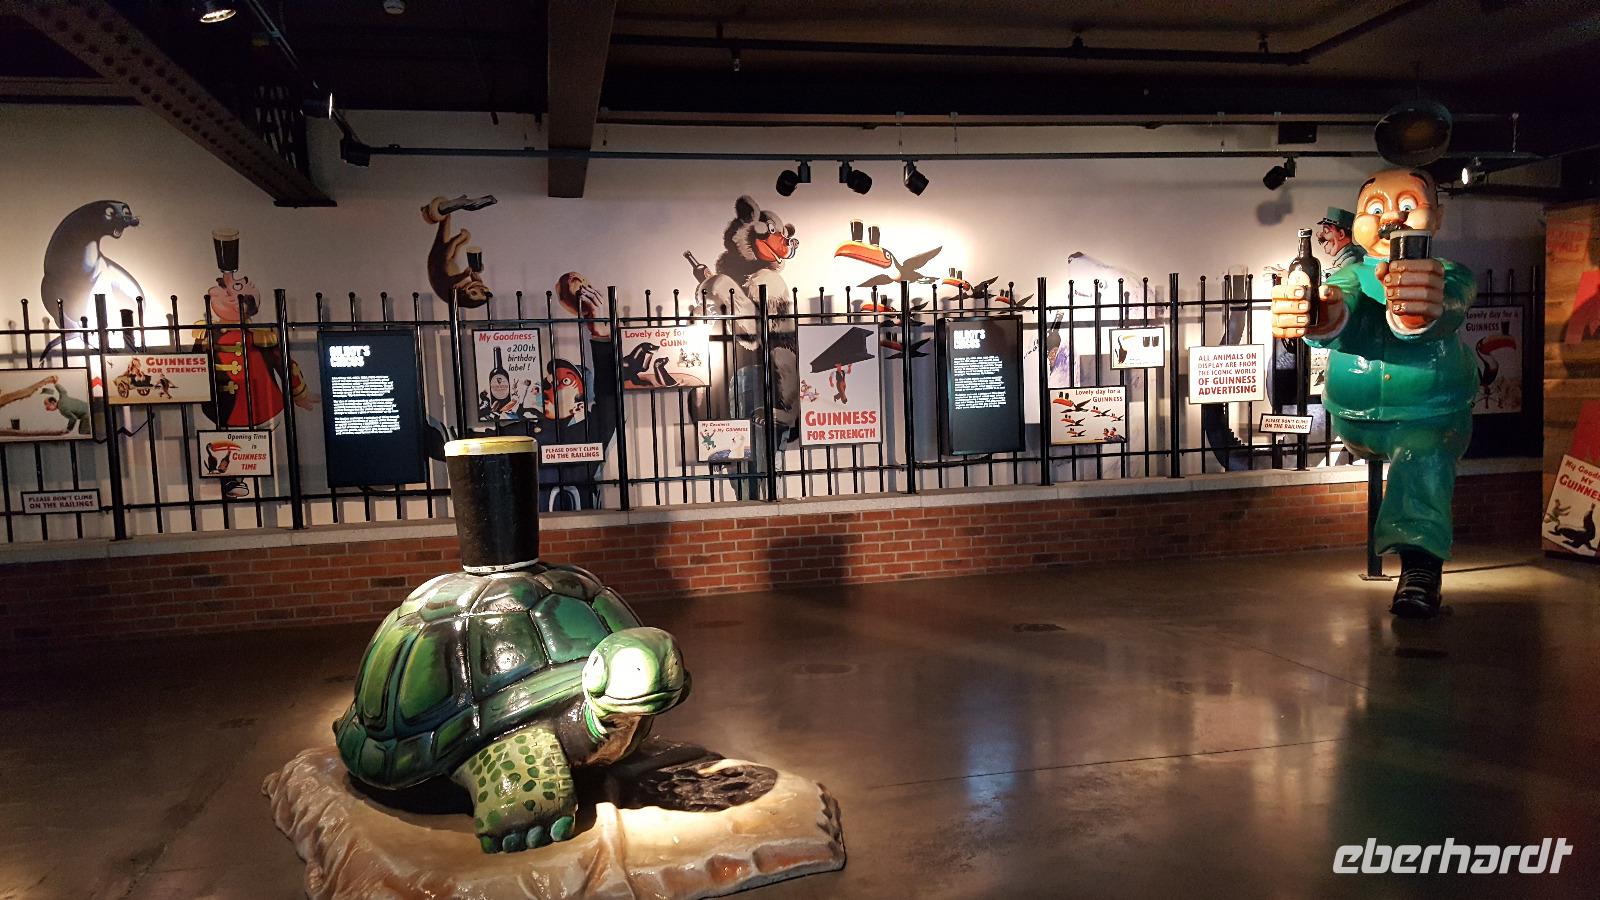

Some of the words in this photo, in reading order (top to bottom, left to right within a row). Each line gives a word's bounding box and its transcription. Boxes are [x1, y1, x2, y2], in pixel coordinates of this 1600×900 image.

[479, 332, 492, 343] My
[493, 332, 536, 341] Goodness-
[624, 330, 653, 339] Lovely
[654, 329, 670, 338] day
[512, 344, 536, 352] 200th
[507, 354, 537, 363] birthday
[1213, 353, 1244, 361] ANIMALS
[1246, 352, 1257, 360] ON
[145, 357, 207, 366] GUINNESS
[166, 366, 207, 374] STRENGTH
[1198, 377, 1210, 386] OF
[1212, 375, 1257, 385] GUINNESS
[1095, 388, 1106, 396] day
[1198, 384, 1257, 396] ADVERTISING
[805, 410, 877, 427] GUINNESS
[227, 433, 252, 442] Opening
[807, 430, 827, 441] FOR
[828, 428, 876, 440] STRENGTH
[232, 452, 267, 461] GUINNESS
[570, 451, 600, 459] RAILINGS
[59, 500, 94, 508] RAILINGS
